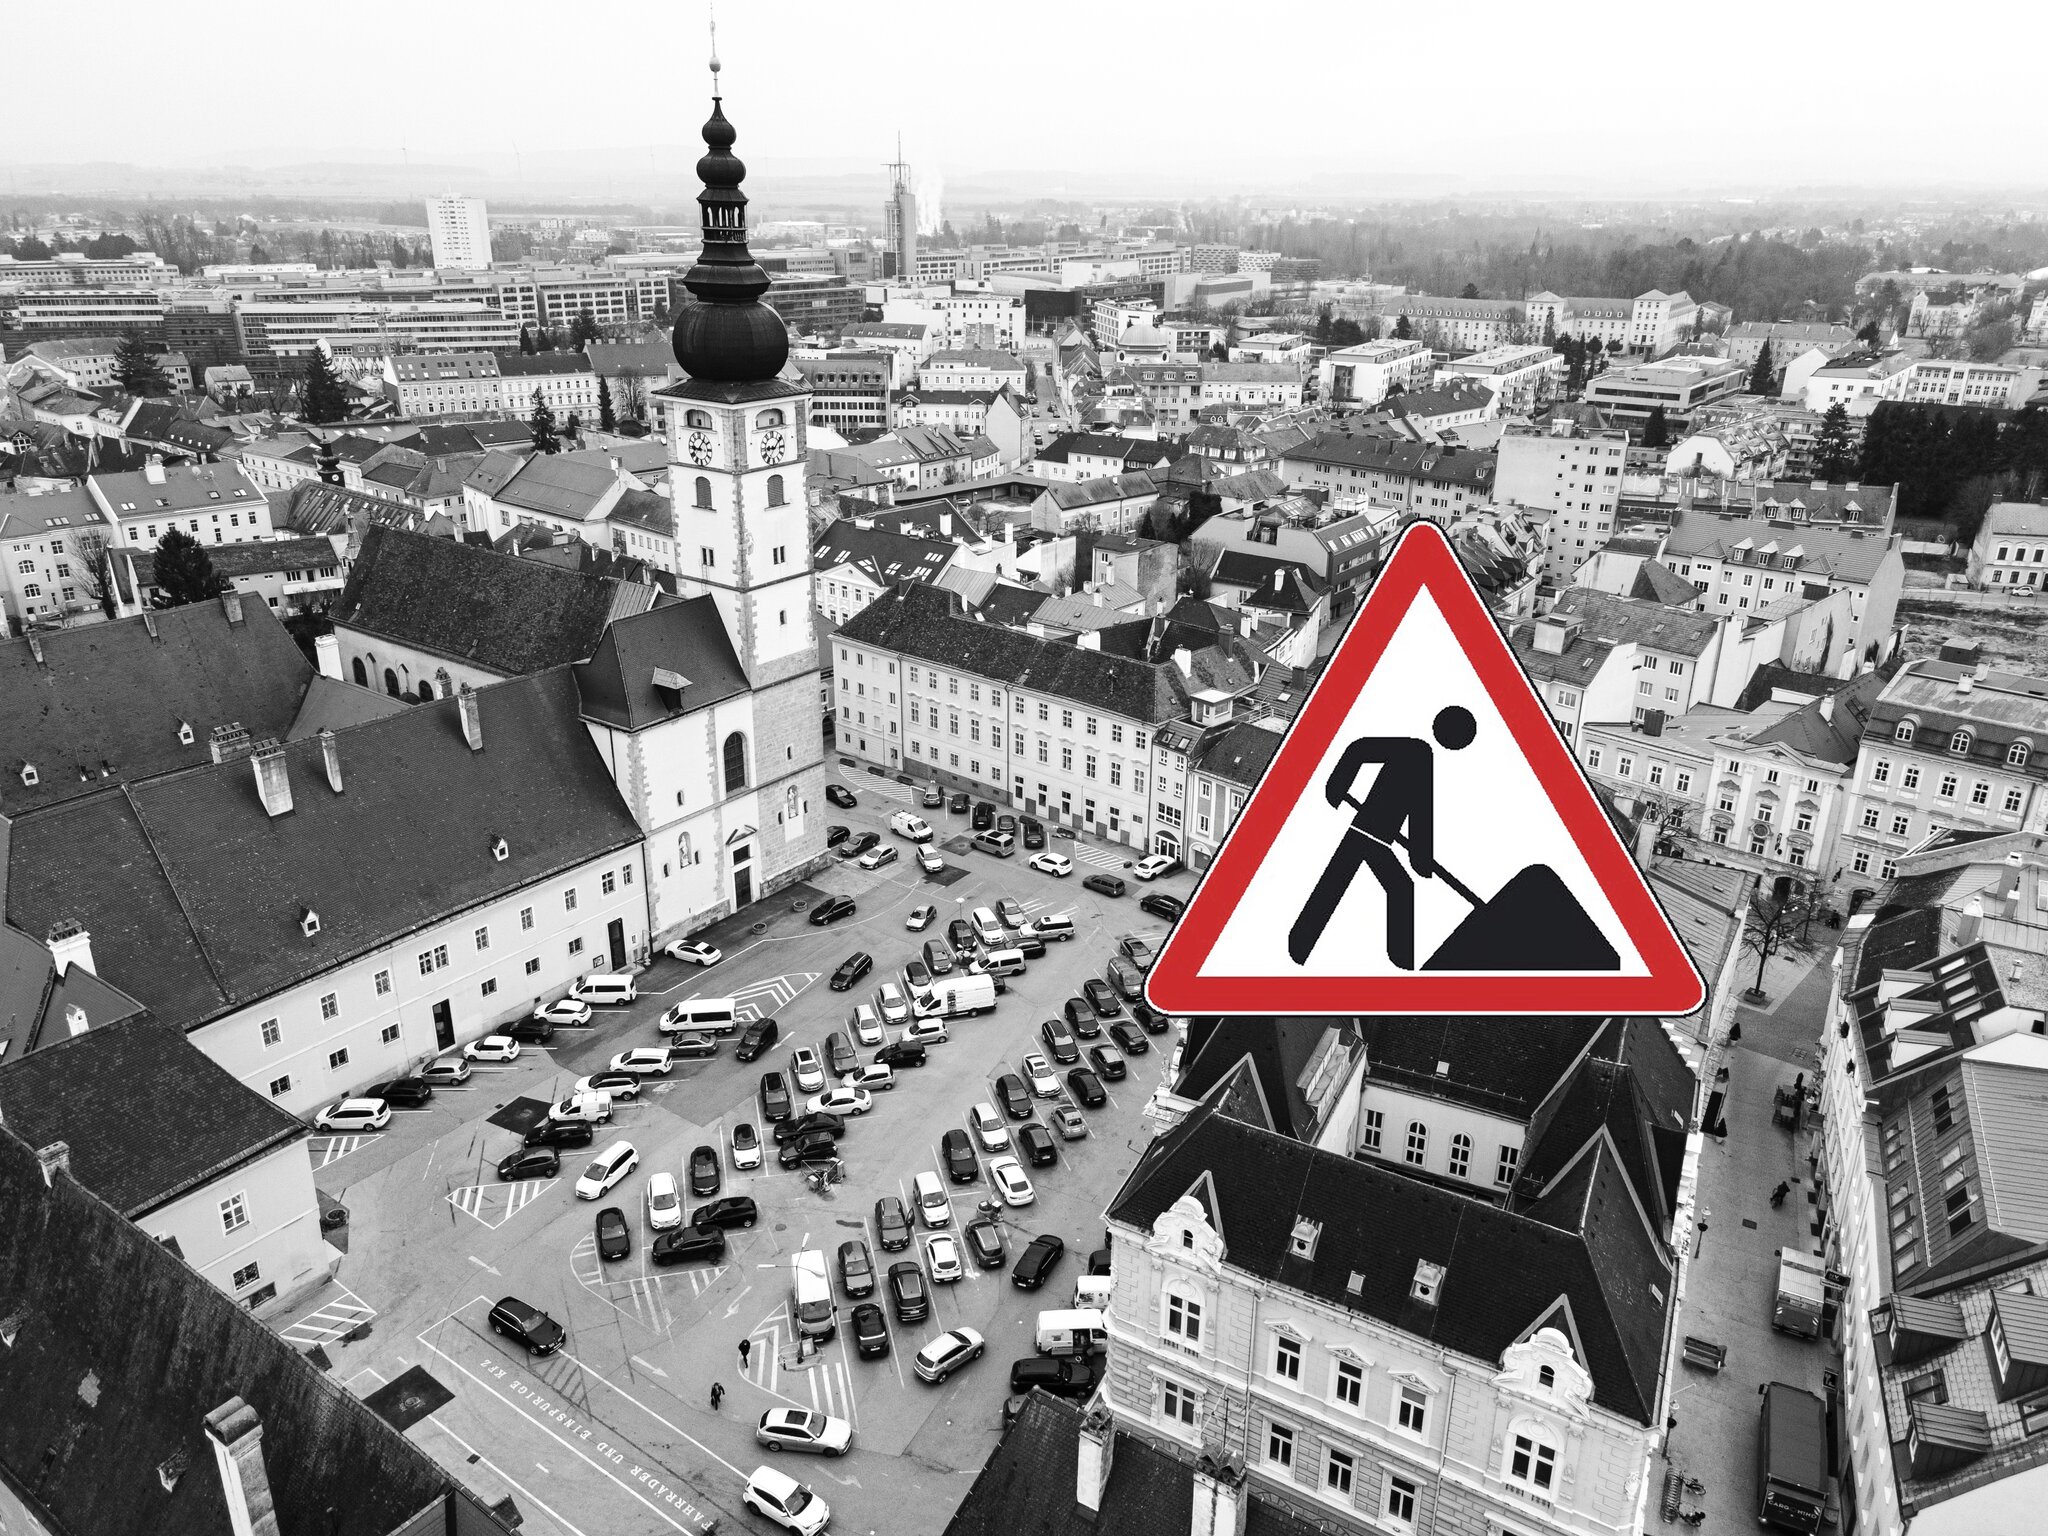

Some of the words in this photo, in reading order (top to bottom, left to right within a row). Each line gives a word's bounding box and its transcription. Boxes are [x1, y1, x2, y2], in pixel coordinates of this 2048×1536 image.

[480, 1359, 507, 1378] KFZ
[509, 1380, 592, 1440] EINSPURIGE
[597, 1442, 624, 1464] UND
[630, 1465, 714, 1531] FAHRRÄDER
